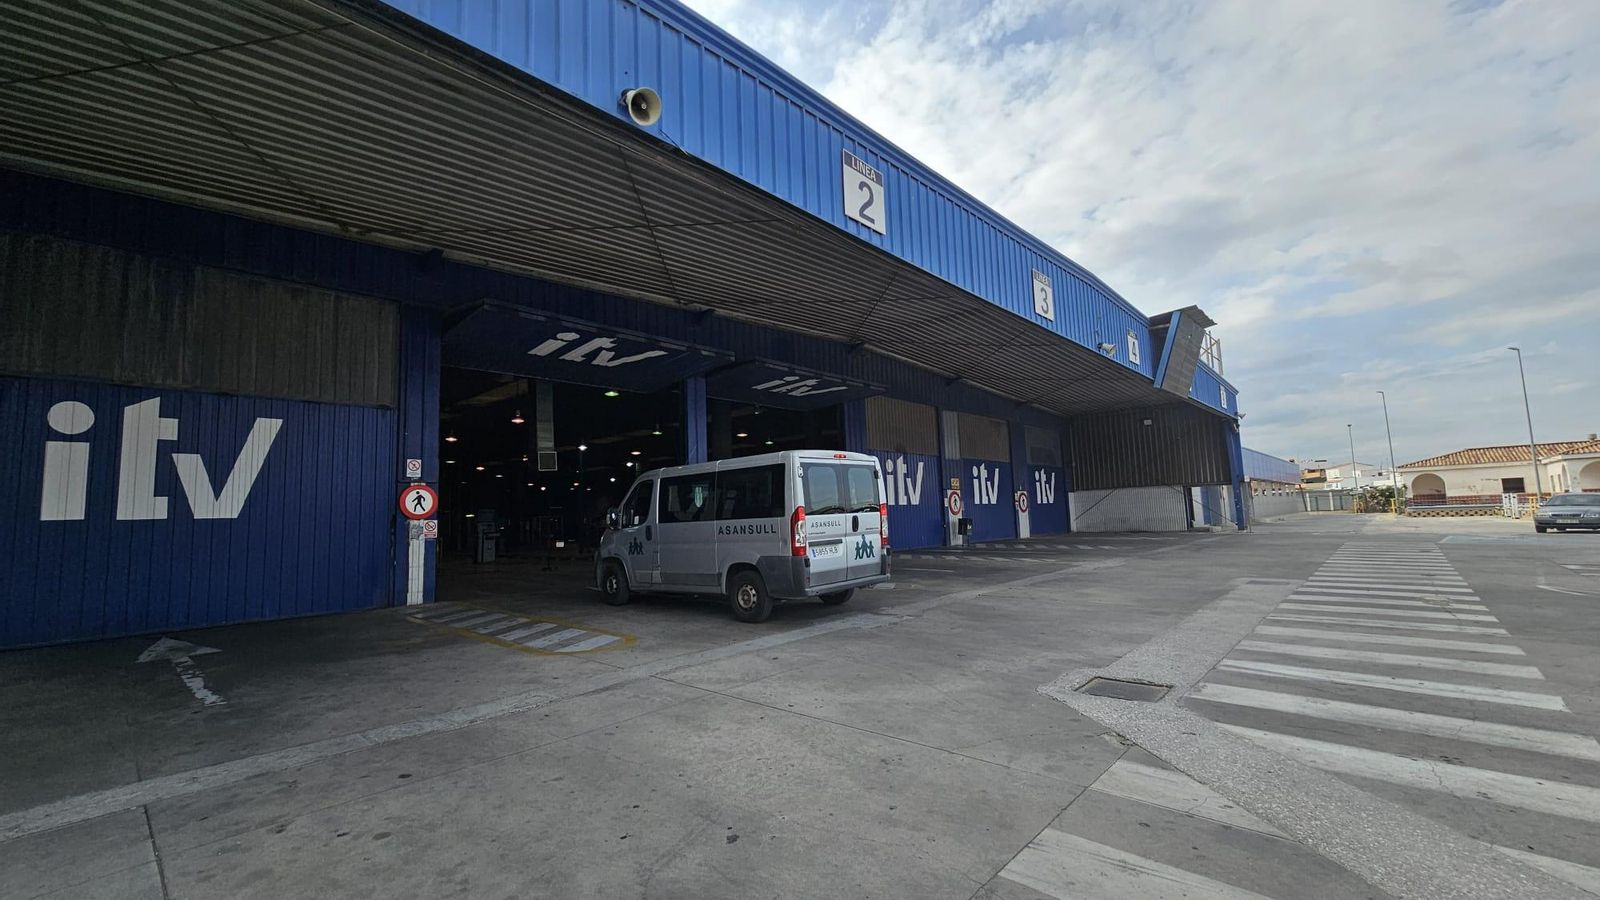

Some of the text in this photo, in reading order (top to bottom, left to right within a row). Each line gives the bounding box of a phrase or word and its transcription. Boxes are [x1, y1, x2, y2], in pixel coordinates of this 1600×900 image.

[858, 181, 875, 225] 2
[1040, 287, 1049, 315] 3
[528, 332, 668, 367] itv
[752, 376, 848, 396] itv
[40, 396, 284, 521] itv
[886, 455, 924, 506] itv
[972, 463, 999, 505] itv
[1035, 468, 1056, 504] itv
[718, 524, 777, 535] ASANSULL
[811, 520, 841, 528] ASANSULL
